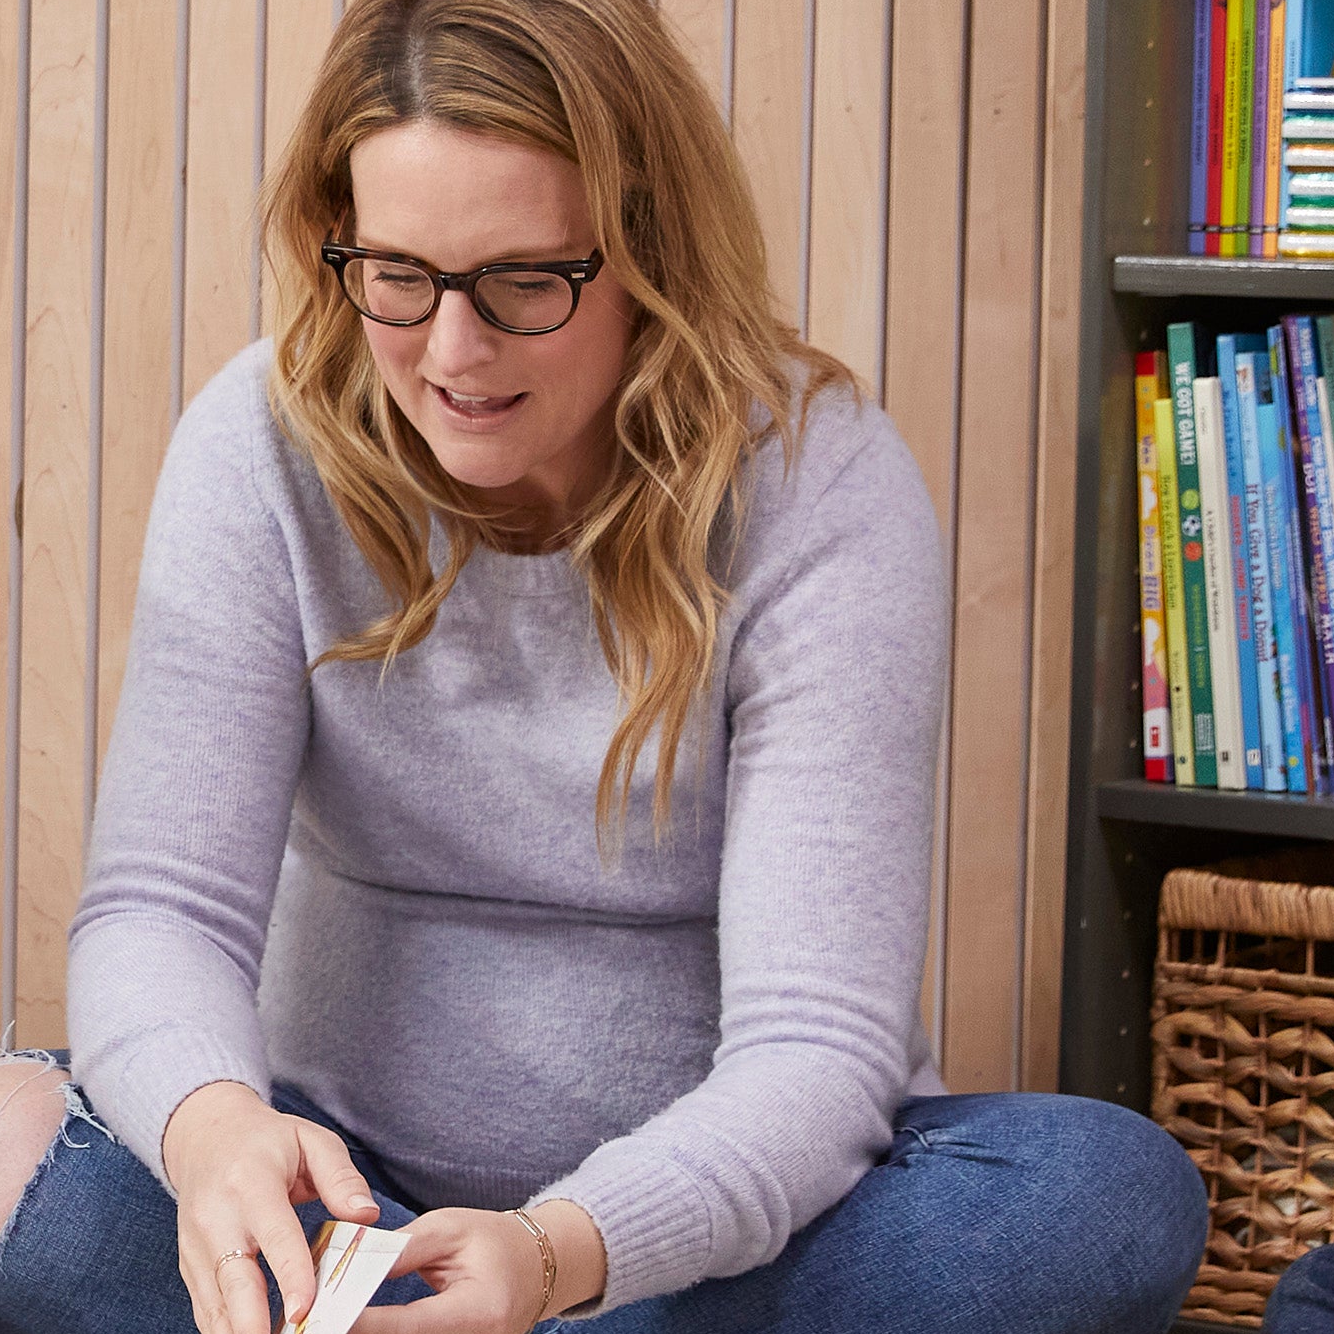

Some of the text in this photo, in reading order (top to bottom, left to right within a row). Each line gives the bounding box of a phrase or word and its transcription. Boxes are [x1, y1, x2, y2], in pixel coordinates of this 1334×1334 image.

[1175, 361, 1196, 465] WE GOT GAME!
[1245, 484, 1258, 495] If
[1247, 499, 1260, 524] You
[1249, 529, 1262, 558] Give
[1252, 576, 1265, 603] Dog
[1255, 620, 1268, 662] Donut
